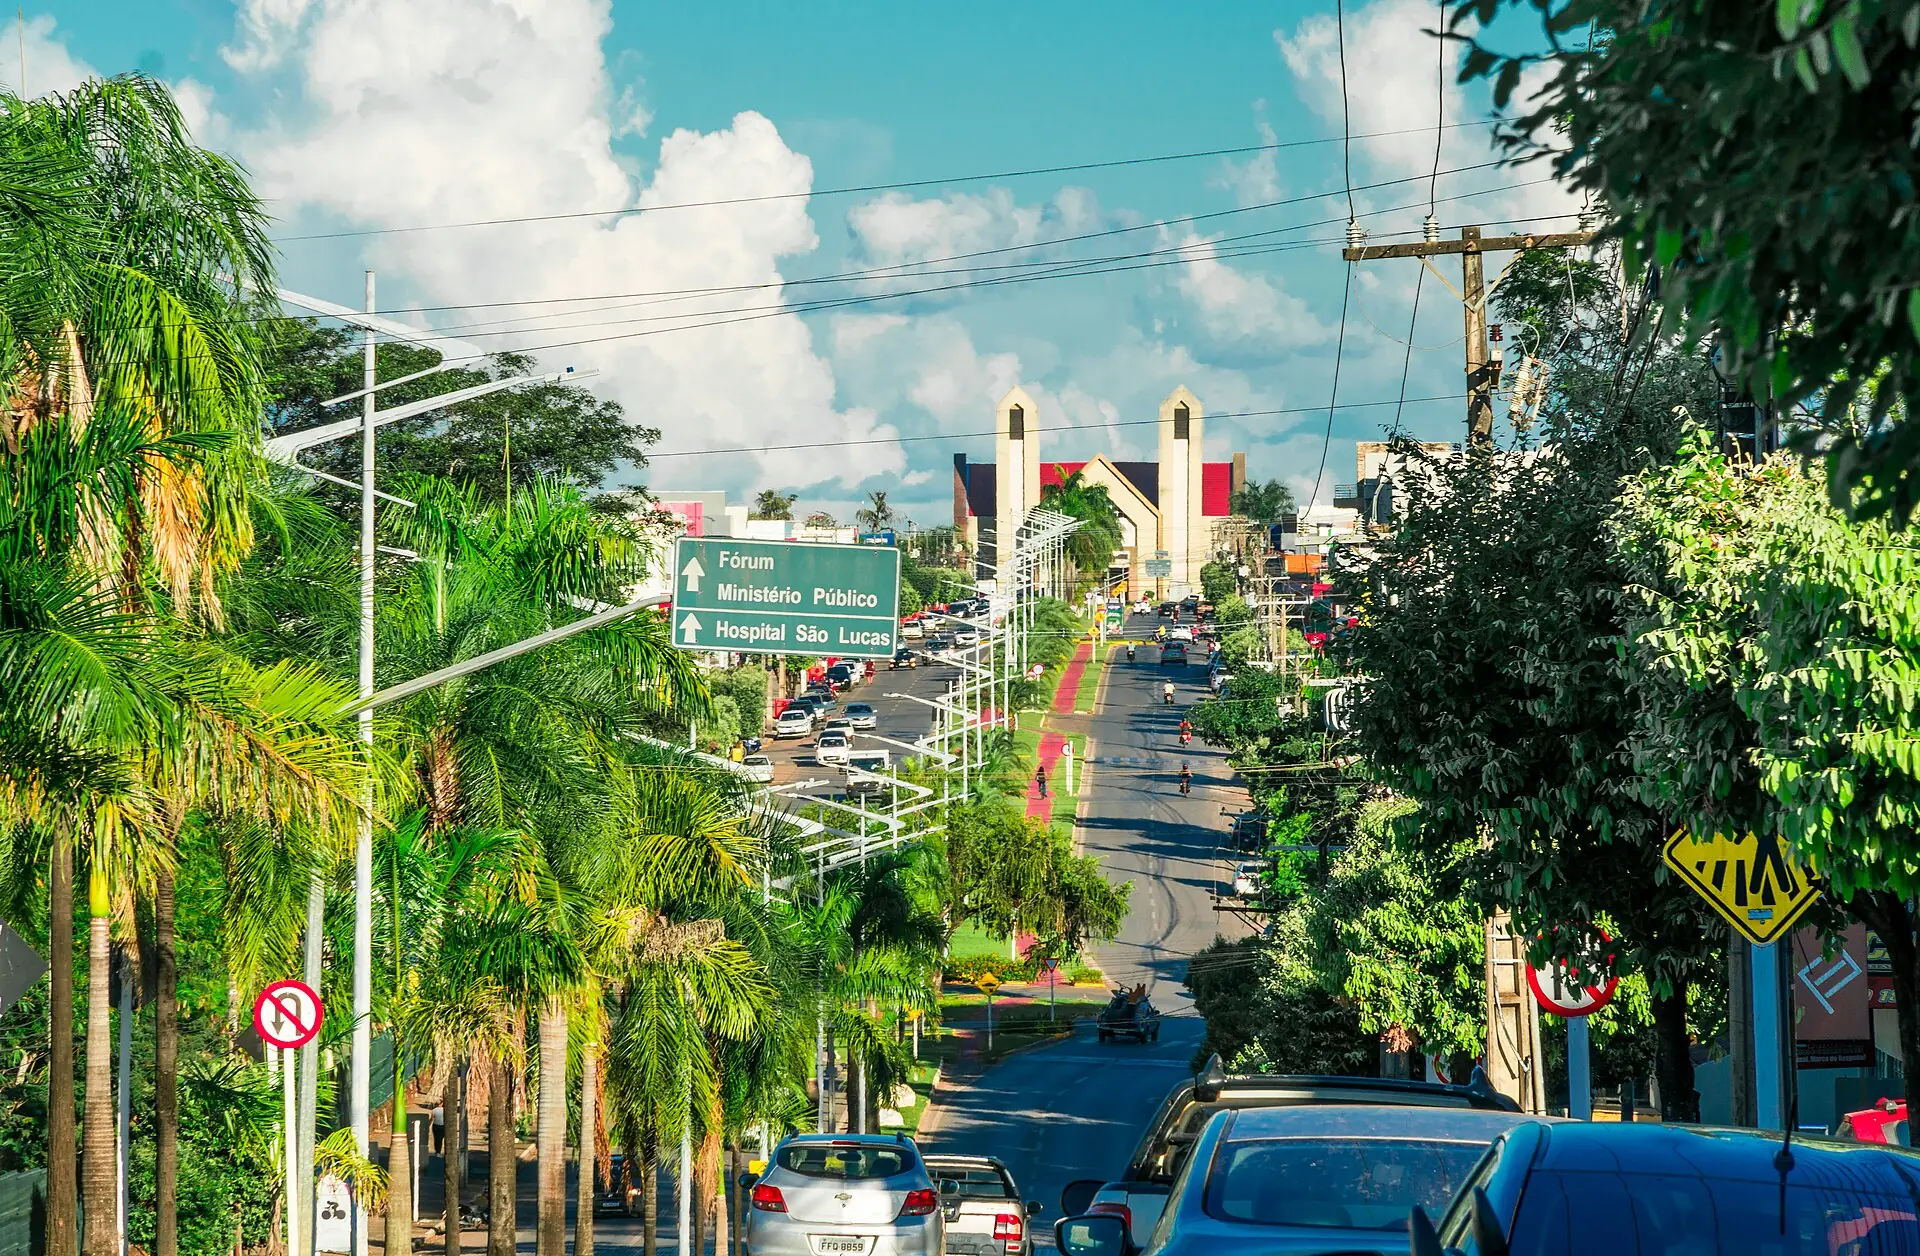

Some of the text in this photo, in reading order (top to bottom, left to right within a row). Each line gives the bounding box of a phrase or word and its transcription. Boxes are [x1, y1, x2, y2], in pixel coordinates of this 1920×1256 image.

[719, 550, 774, 570] Fórum
[718, 584, 878, 608] Ministério Público
[715, 620, 890, 646] Hospital São Lucas
